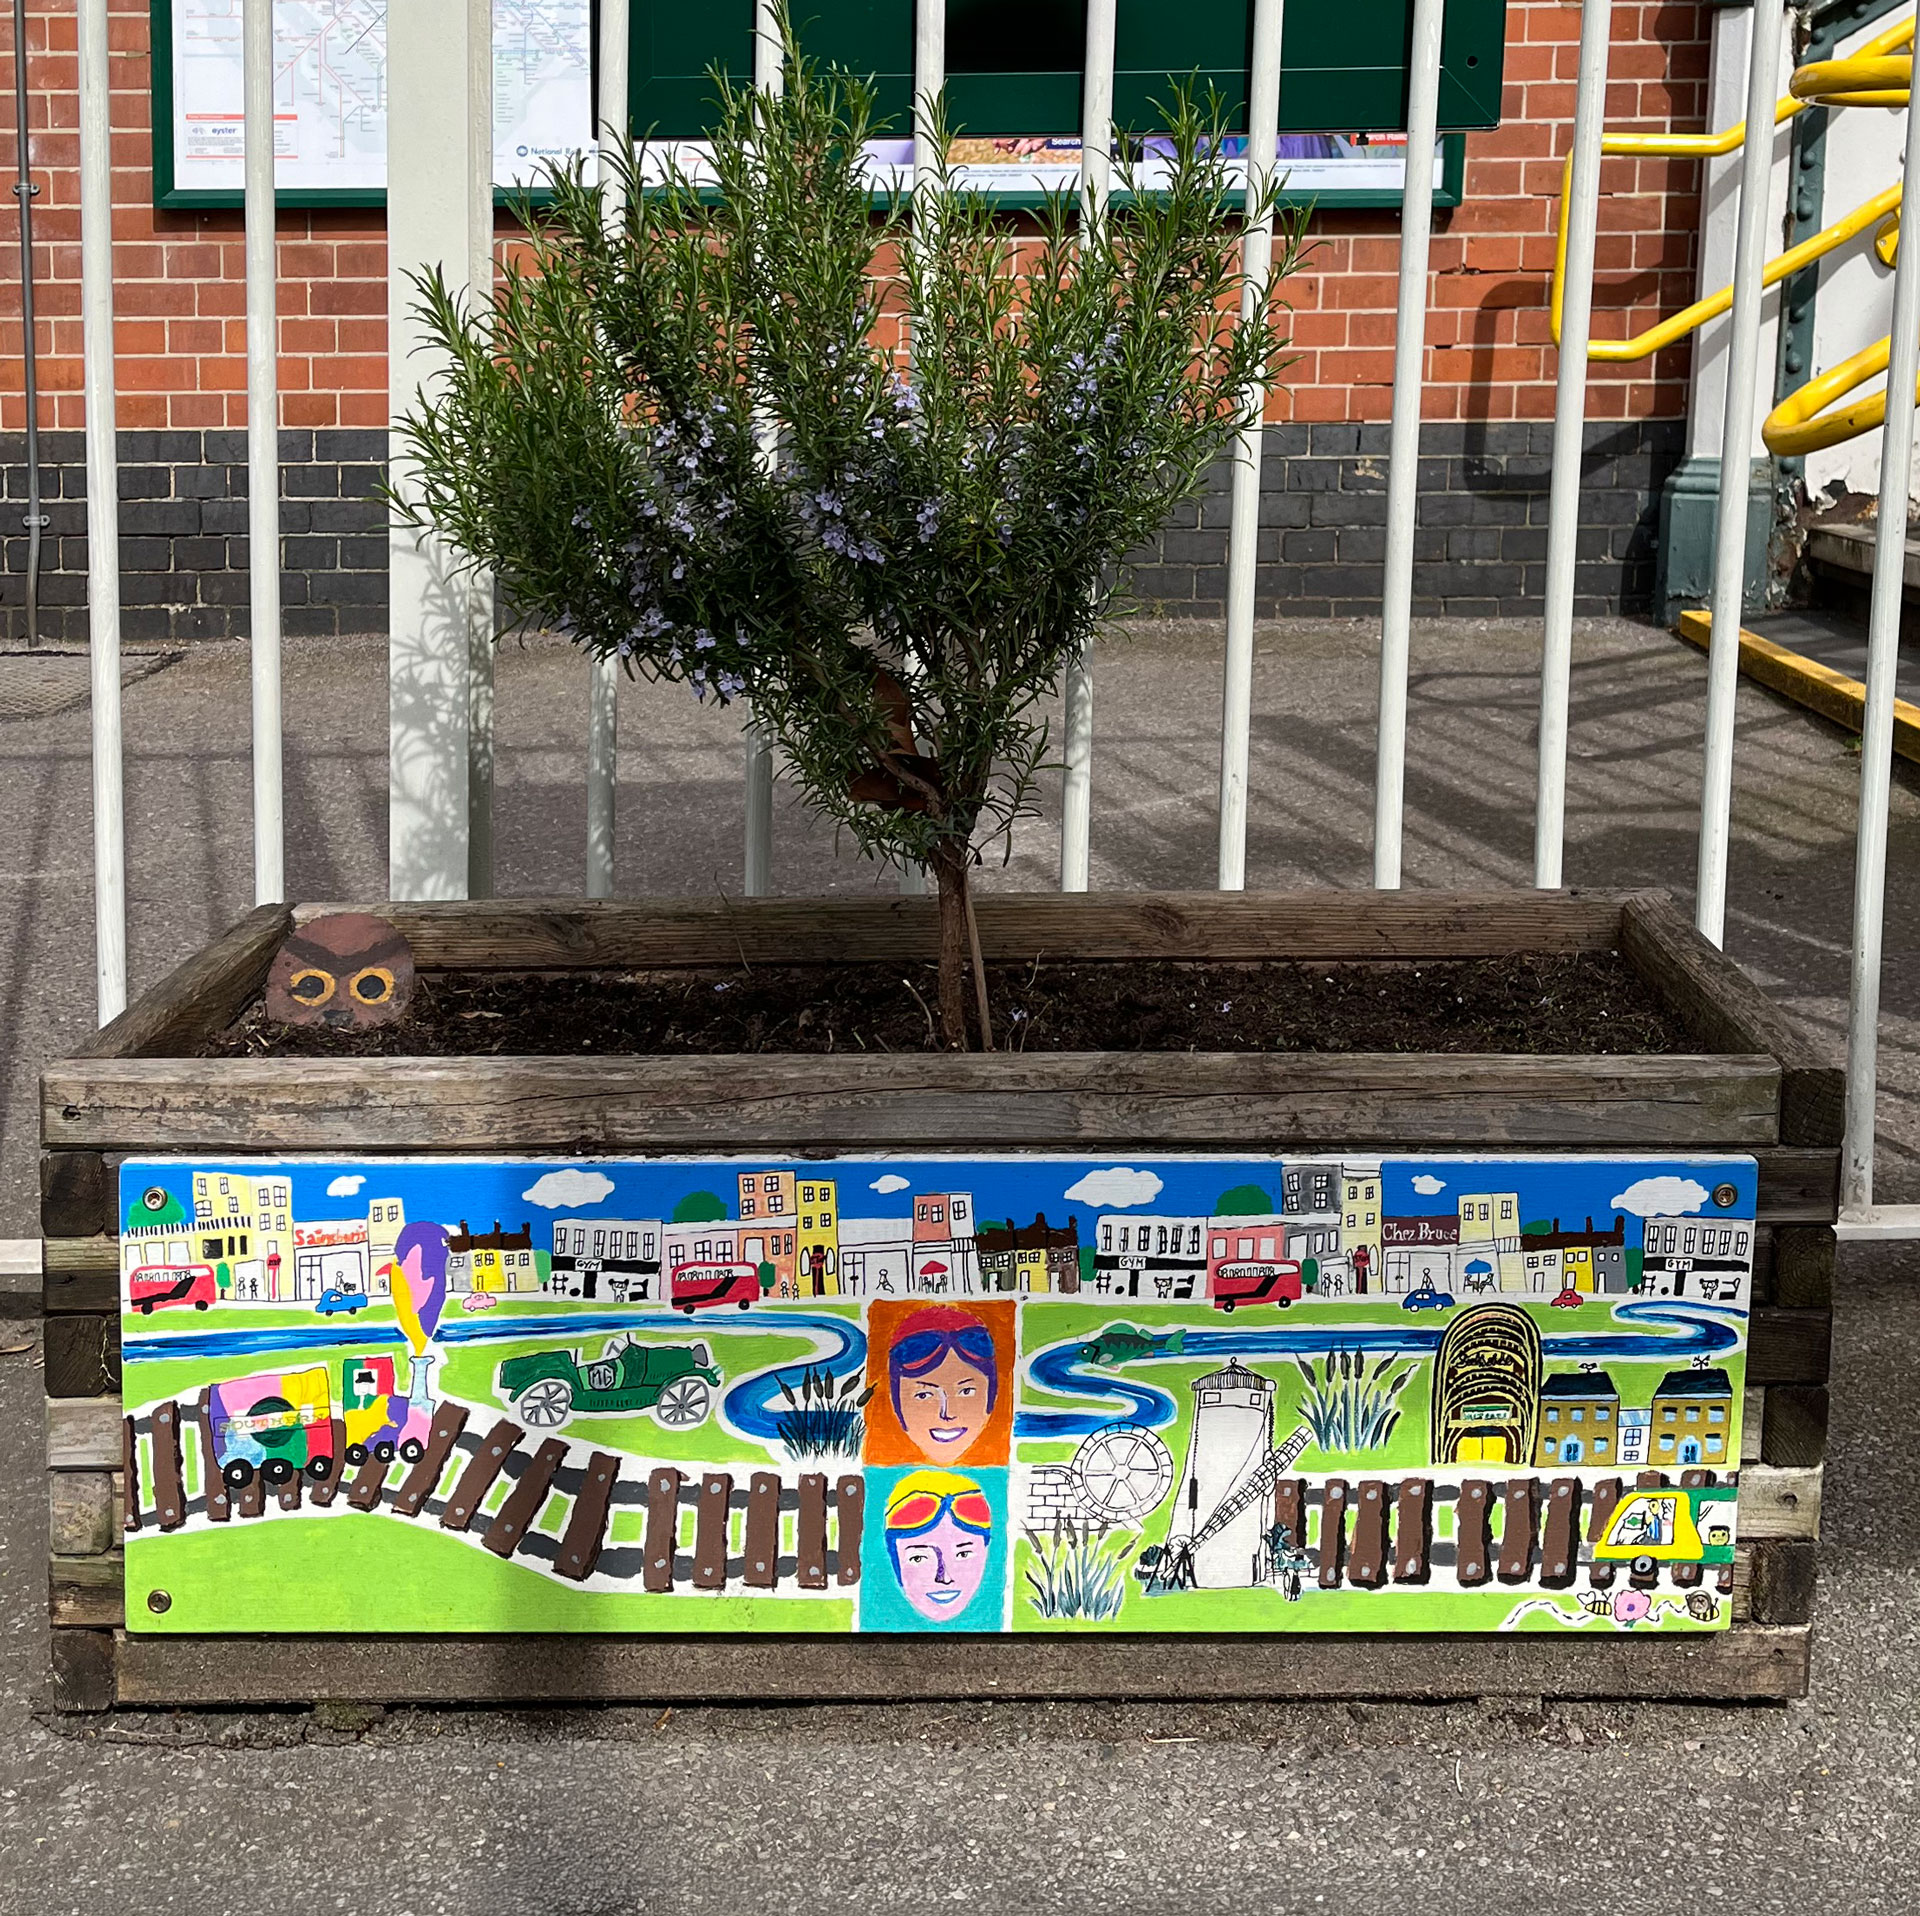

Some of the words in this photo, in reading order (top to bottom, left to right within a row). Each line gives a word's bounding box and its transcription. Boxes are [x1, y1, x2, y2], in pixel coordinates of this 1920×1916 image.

[530, 147, 563, 156] National
[1382, 1222, 1416, 1241] Chez
[1417, 1222, 1458, 1241] Bruce
[576, 1259, 601, 1271] GYM
[1120, 1256, 1144, 1268] GYM
[1667, 1259, 1691, 1270] GYM
[590, 1366, 614, 1388] MG
[219, 1411, 326, 1434] SOUTHERN
